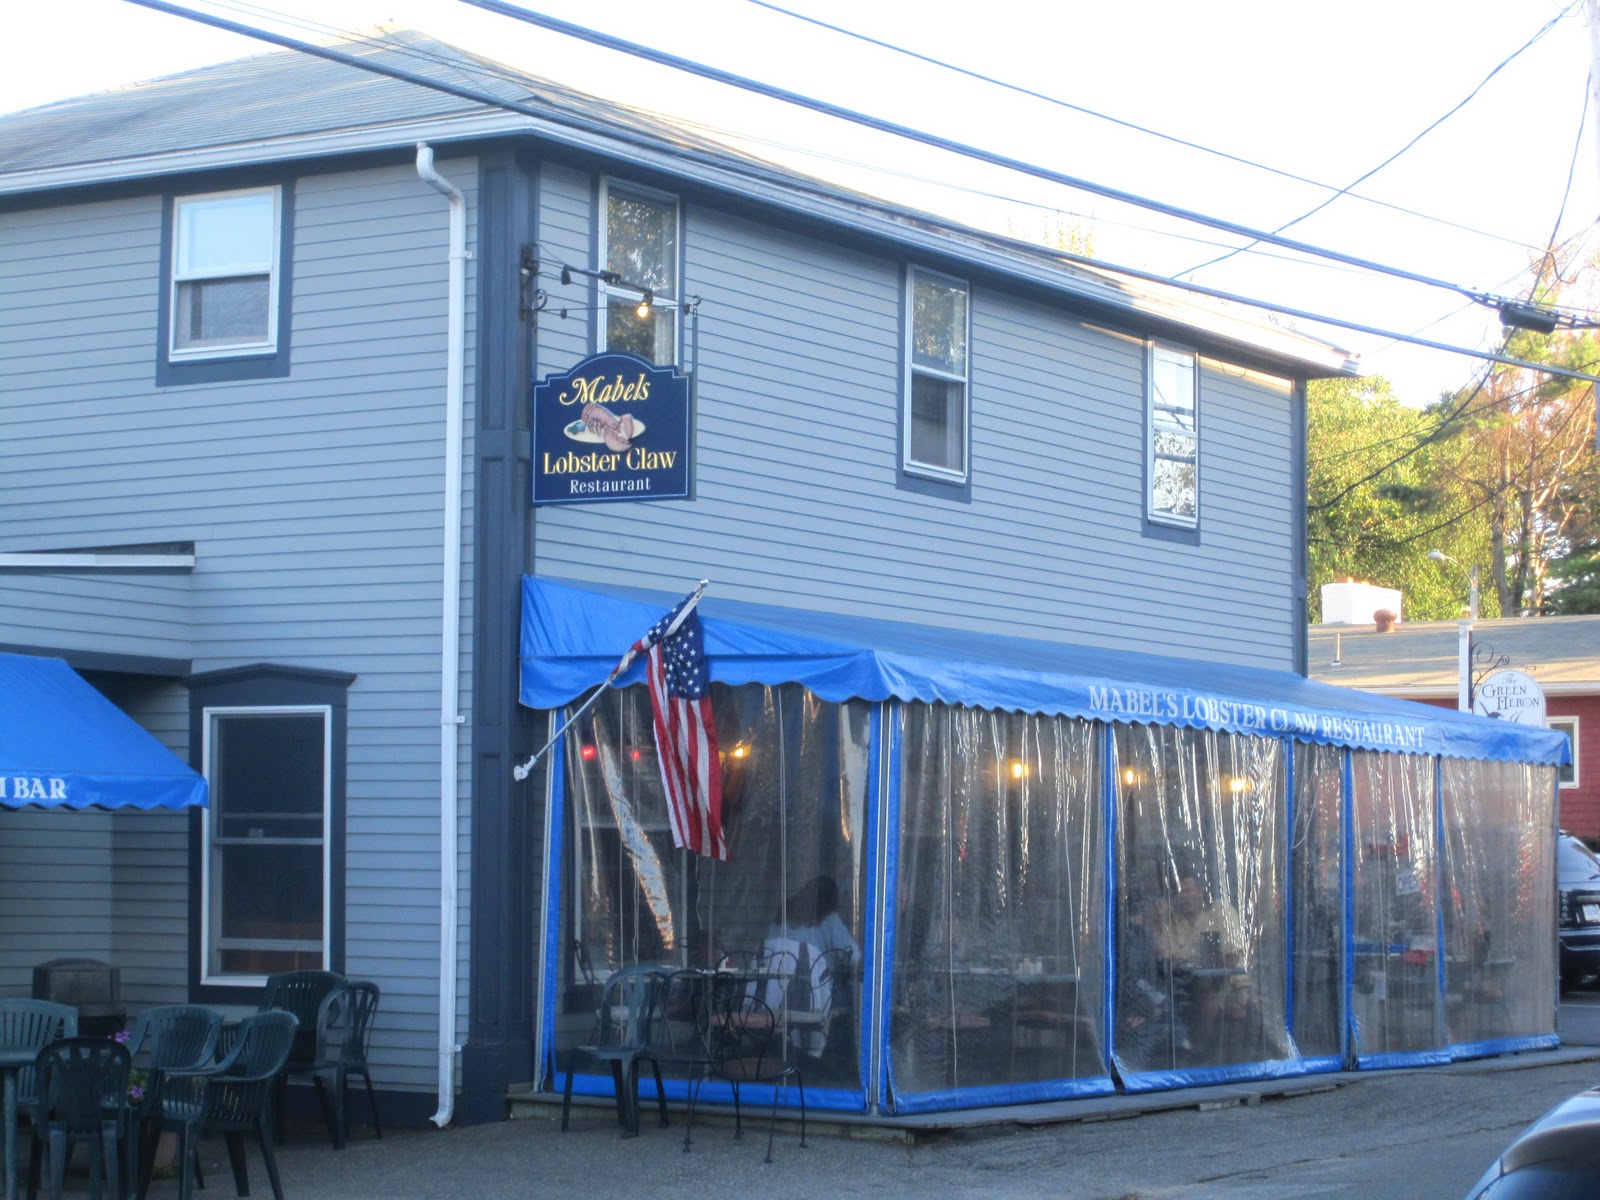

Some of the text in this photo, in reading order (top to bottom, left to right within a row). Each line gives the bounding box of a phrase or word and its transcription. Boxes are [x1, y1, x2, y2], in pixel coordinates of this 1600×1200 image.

[559, 373, 651, 406] Mabels
[543, 447, 677, 475] Lobster Claw
[570, 477, 651, 494] Restaurant
[1501, 673, 1517, 685] The
[1481, 684, 1527, 699] GREEN
[1496, 696, 1540, 710] HERON
[1088, 685, 1425, 748] MABEL'S LOBSTER CLAW RESTAURANT
[13, 777, 68, 799] BAR
